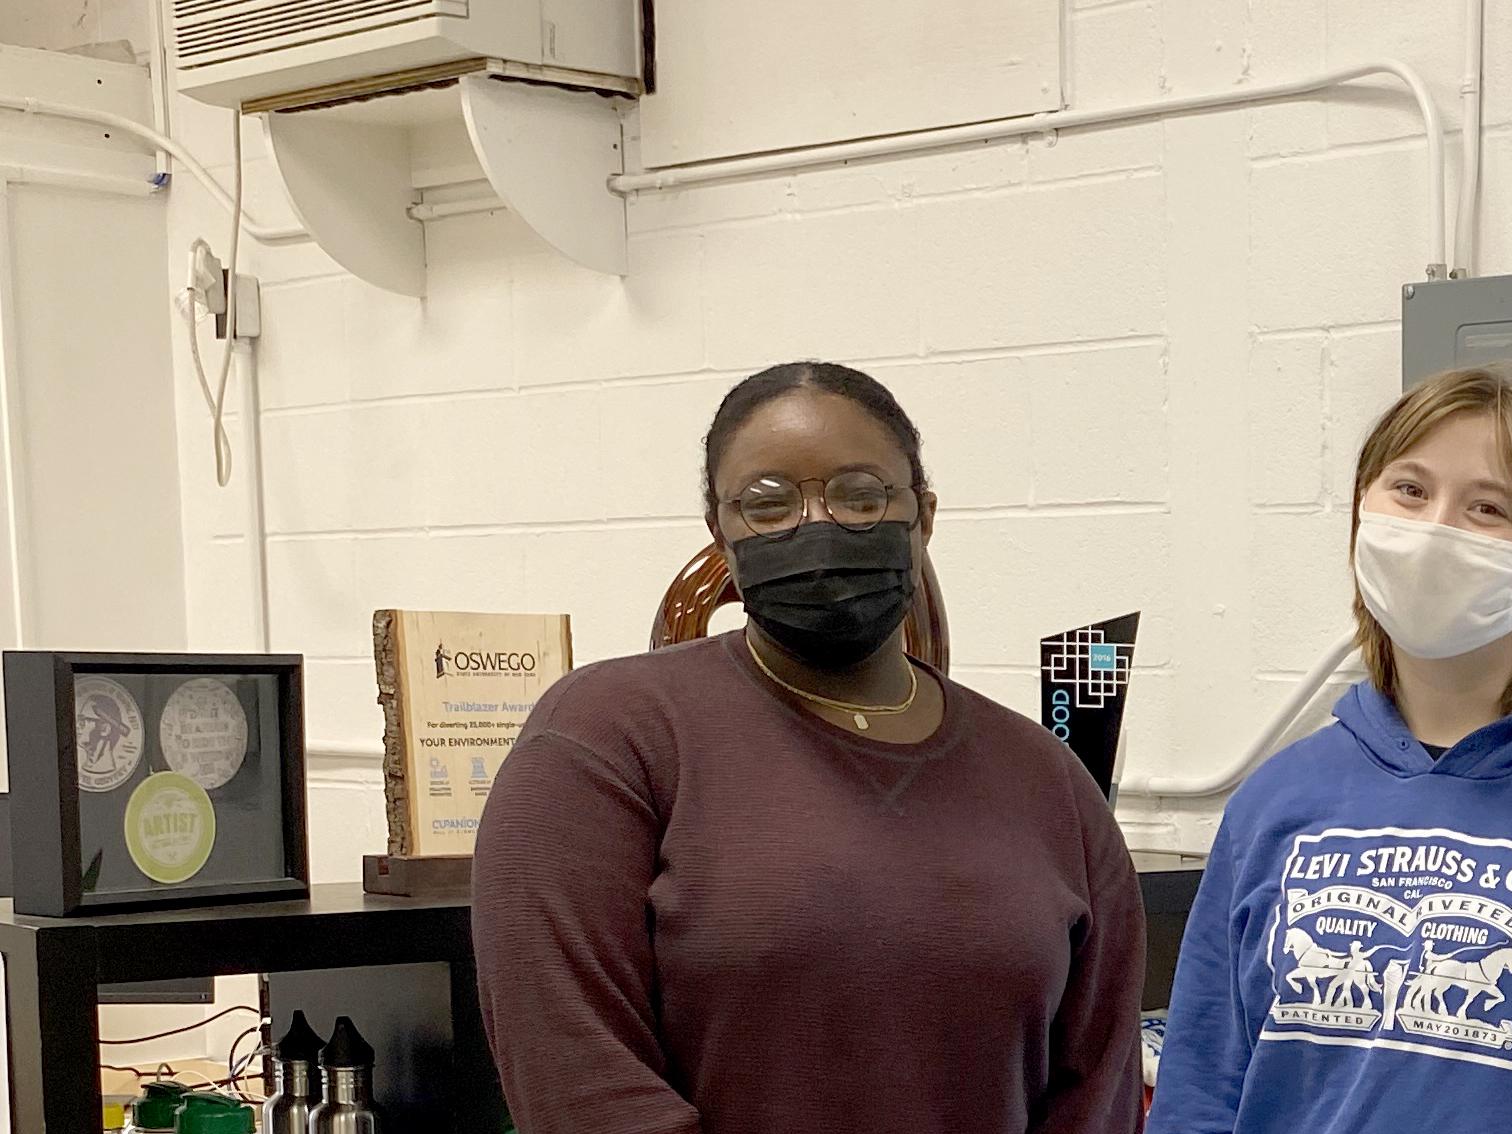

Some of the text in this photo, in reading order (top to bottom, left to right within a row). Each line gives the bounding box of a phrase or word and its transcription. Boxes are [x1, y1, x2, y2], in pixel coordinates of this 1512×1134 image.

[454, 651, 535, 671] OSWEGO
[442, 702, 498, 713] Trailblazer
[420, 738, 446, 747] YOUR
[1290, 852, 1351, 879] LEVI
[1356, 846, 1477, 883] STRAUSS
[1479, 864, 1500, 889] &
[1371, 876, 1453, 890] SAN FRANCISCO
[1292, 892, 1409, 926] ORIGINAL
[1316, 916, 1488, 945] QUALITY CLOTHING
[1281, 1010, 1364, 1025] PATENTED
[1463, 1029, 1498, 1042] 1873
